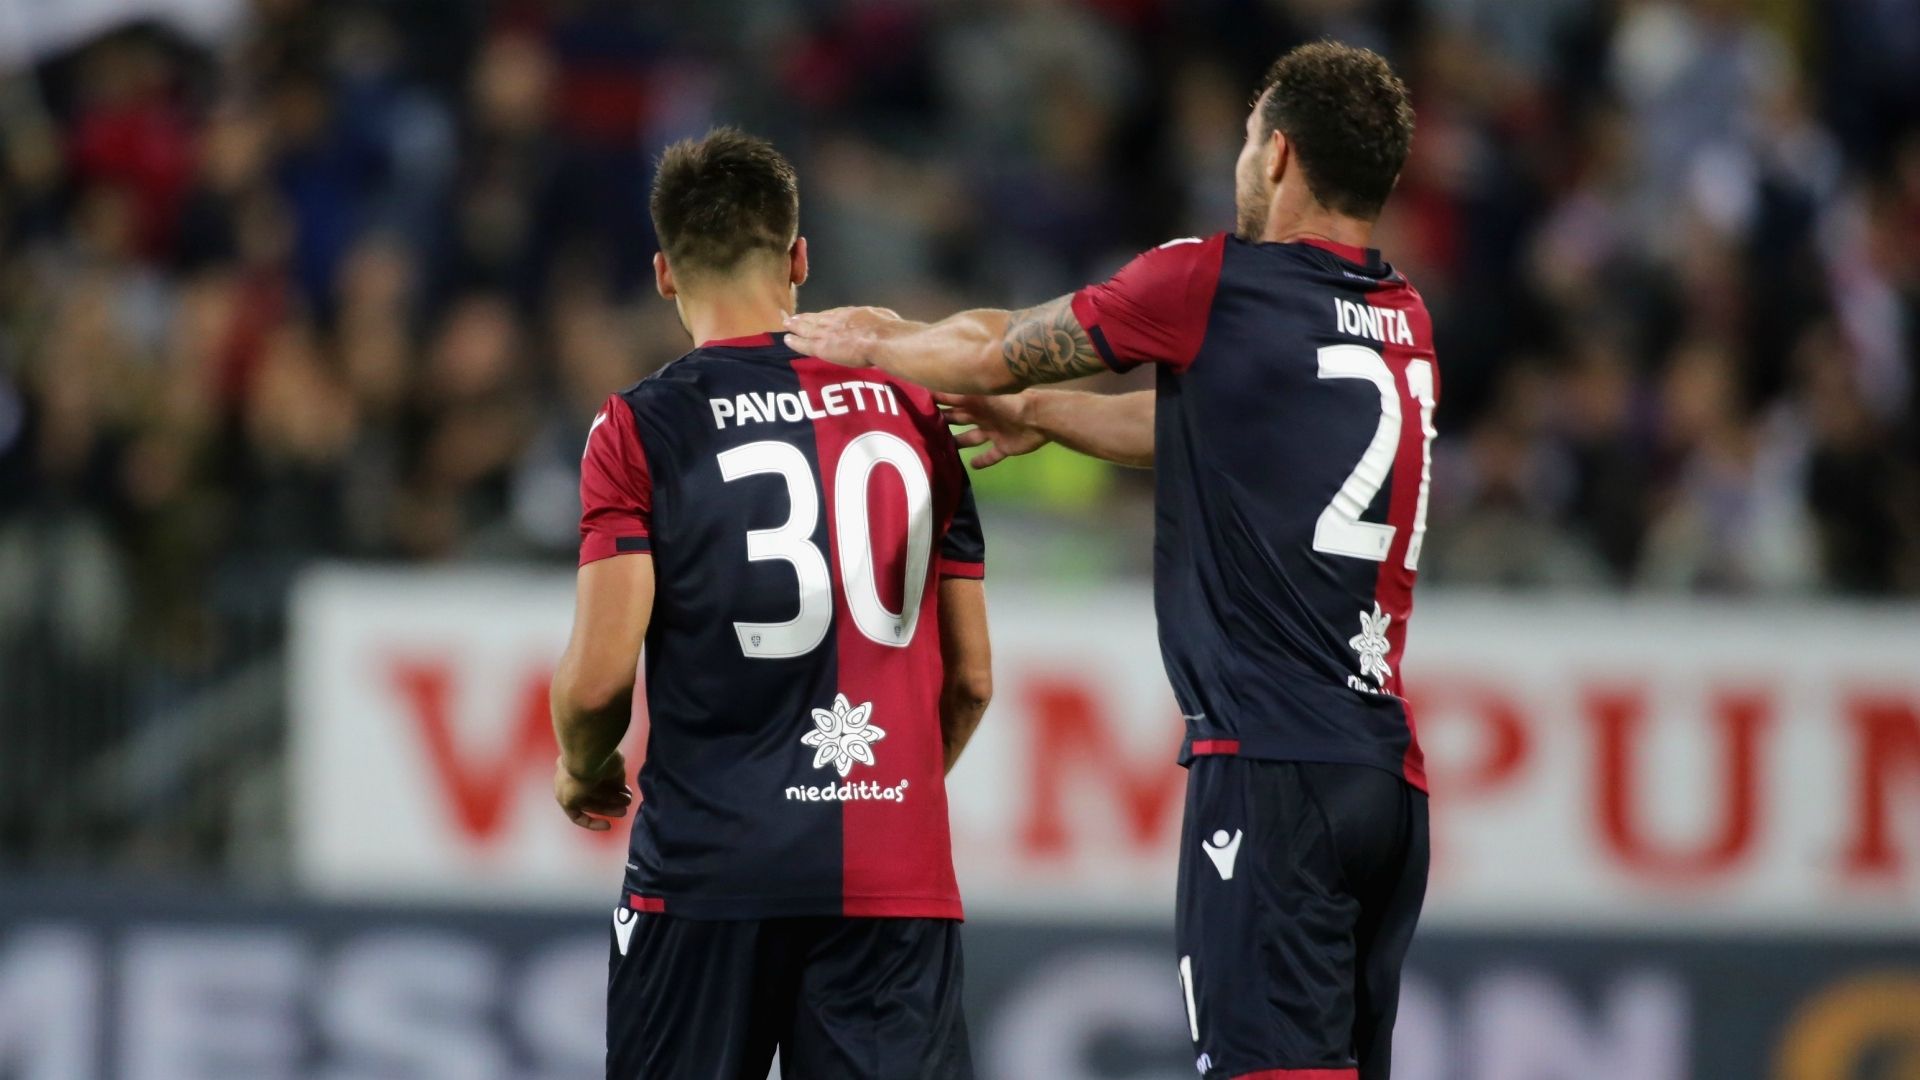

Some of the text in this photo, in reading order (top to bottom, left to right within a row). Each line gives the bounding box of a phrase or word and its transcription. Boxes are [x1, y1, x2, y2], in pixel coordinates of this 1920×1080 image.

[1334, 296, 1414, 346] IONITA
[709, 380, 899, 430] PAVOLETTI
[1312, 344, 1438, 571] 21
[716, 430, 933, 659] 30
[785, 780, 904, 803] nieddittas
